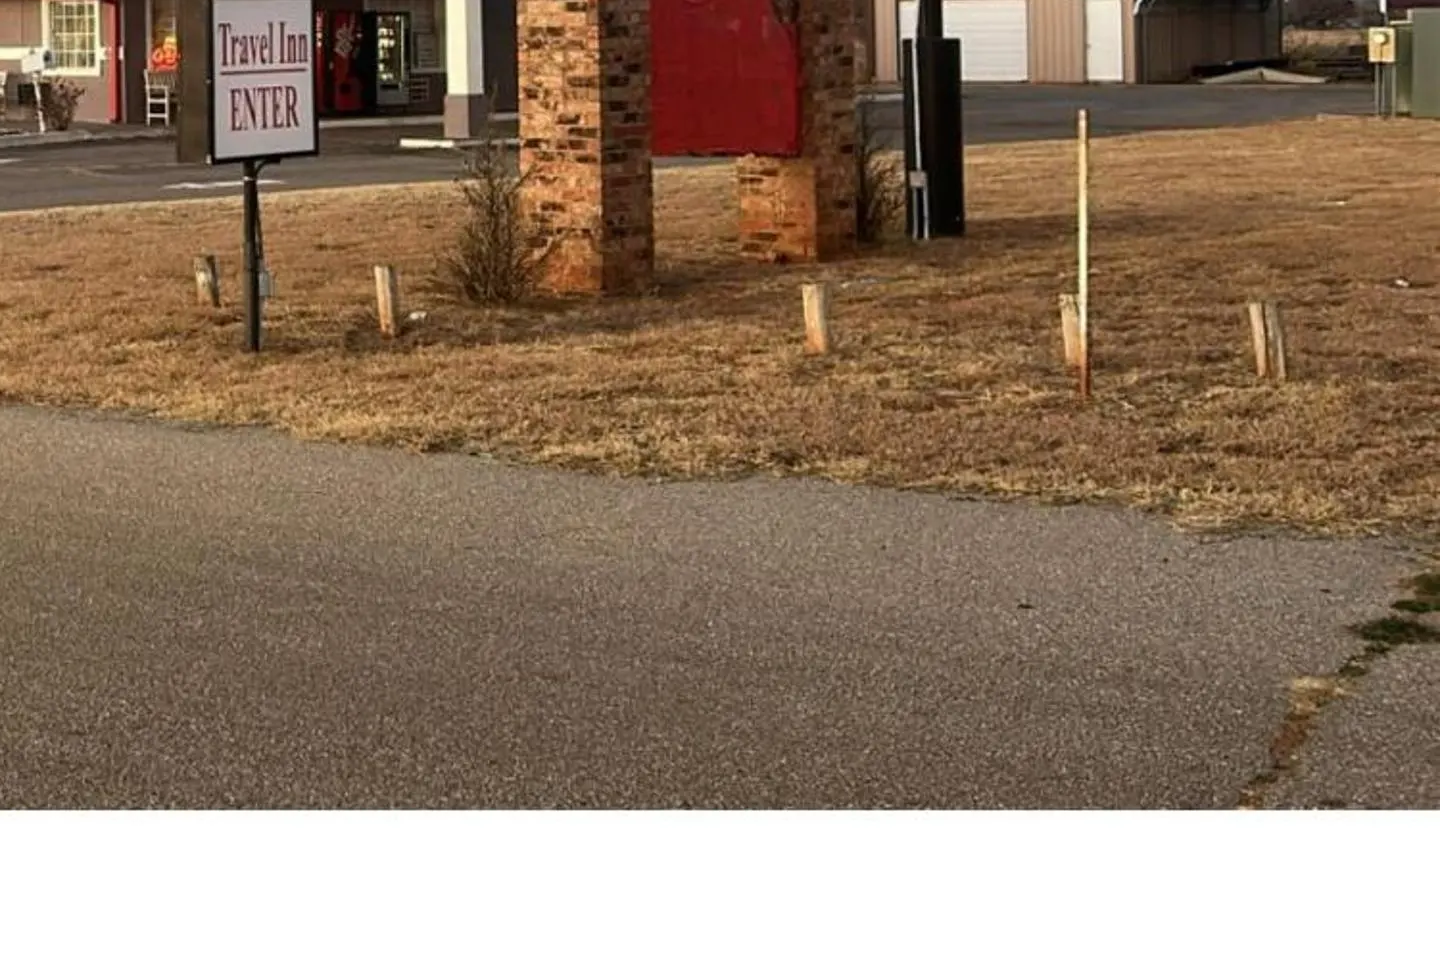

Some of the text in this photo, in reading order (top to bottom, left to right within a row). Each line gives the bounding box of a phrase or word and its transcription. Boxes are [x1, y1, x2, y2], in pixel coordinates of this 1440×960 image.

[218, 21, 274, 67] Travel
[279, 21, 309, 65] Inn
[229, 86, 300, 132] ENTER
